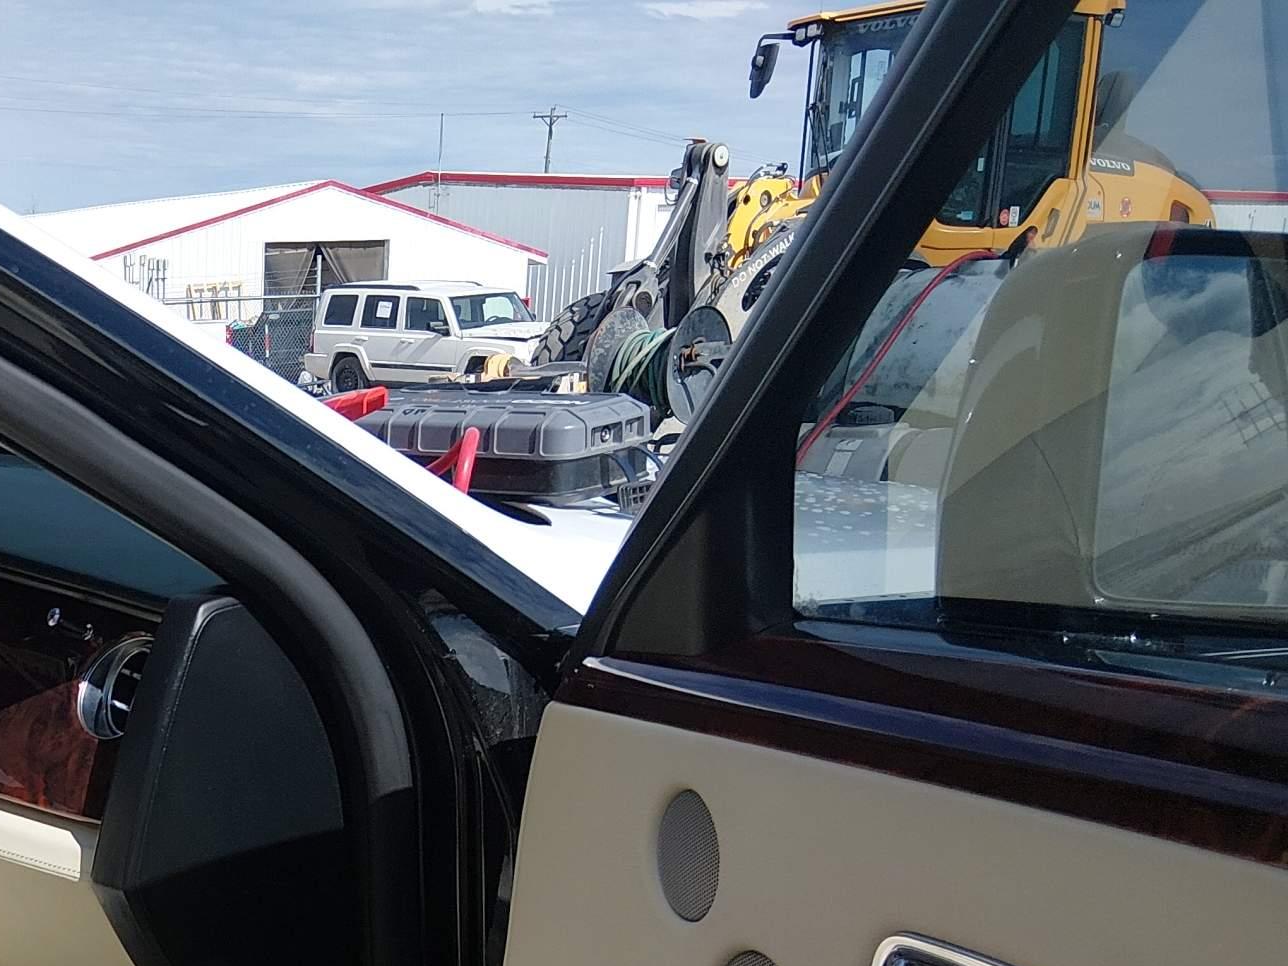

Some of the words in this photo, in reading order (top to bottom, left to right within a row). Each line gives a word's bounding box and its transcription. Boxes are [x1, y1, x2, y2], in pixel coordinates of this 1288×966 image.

[1090, 157, 1131, 171] VOLVO
[731, 271, 748, 288] DO
[747, 253, 770, 273] NOT
[768, 231, 796, 256] WALK
